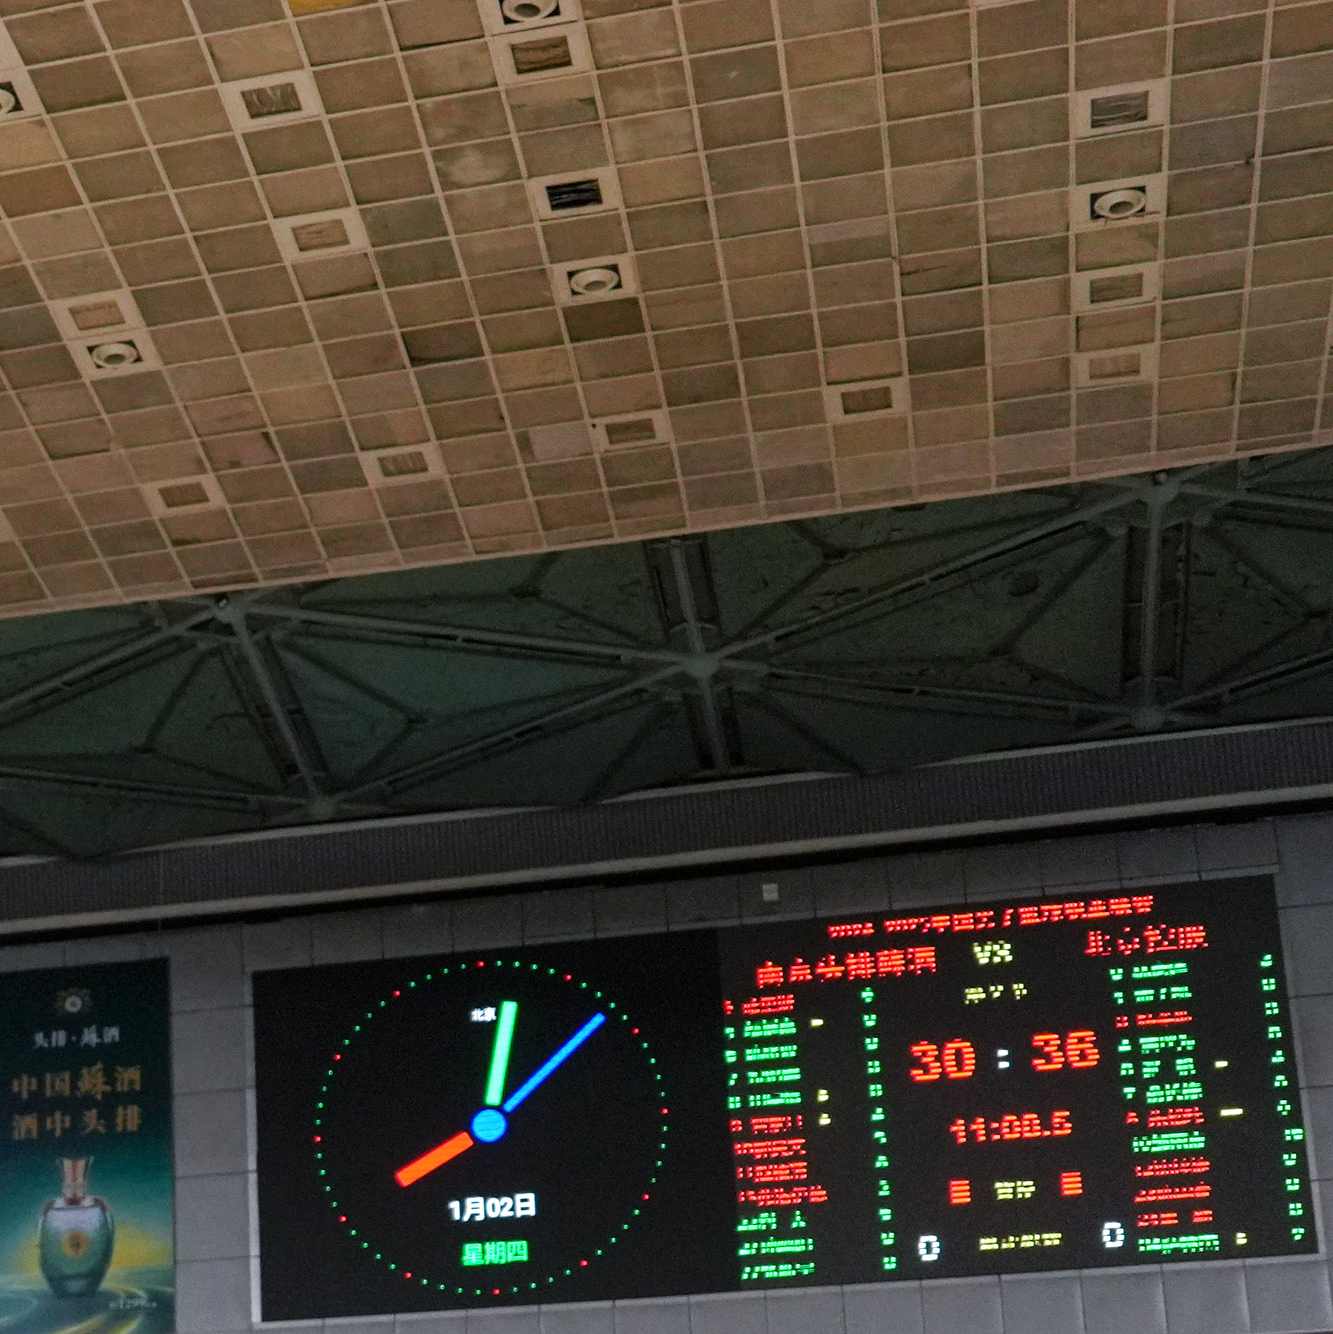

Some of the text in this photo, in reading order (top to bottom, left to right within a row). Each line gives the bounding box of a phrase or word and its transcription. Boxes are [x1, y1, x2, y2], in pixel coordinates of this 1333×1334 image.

[910, 1037, 976, 1082] 30
[1031, 1029, 1101, 1071] 36
[12, 1106, 142, 1140] 酒中头排
[949, 1110, 1073, 1145] 11:00.5
[448, 1193, 538, 1222] 1月02日
[918, 1234, 942, 1262] 0
[1101, 1221, 1126, 1249] 0
[461, 1240, 530, 1267] 星期四
